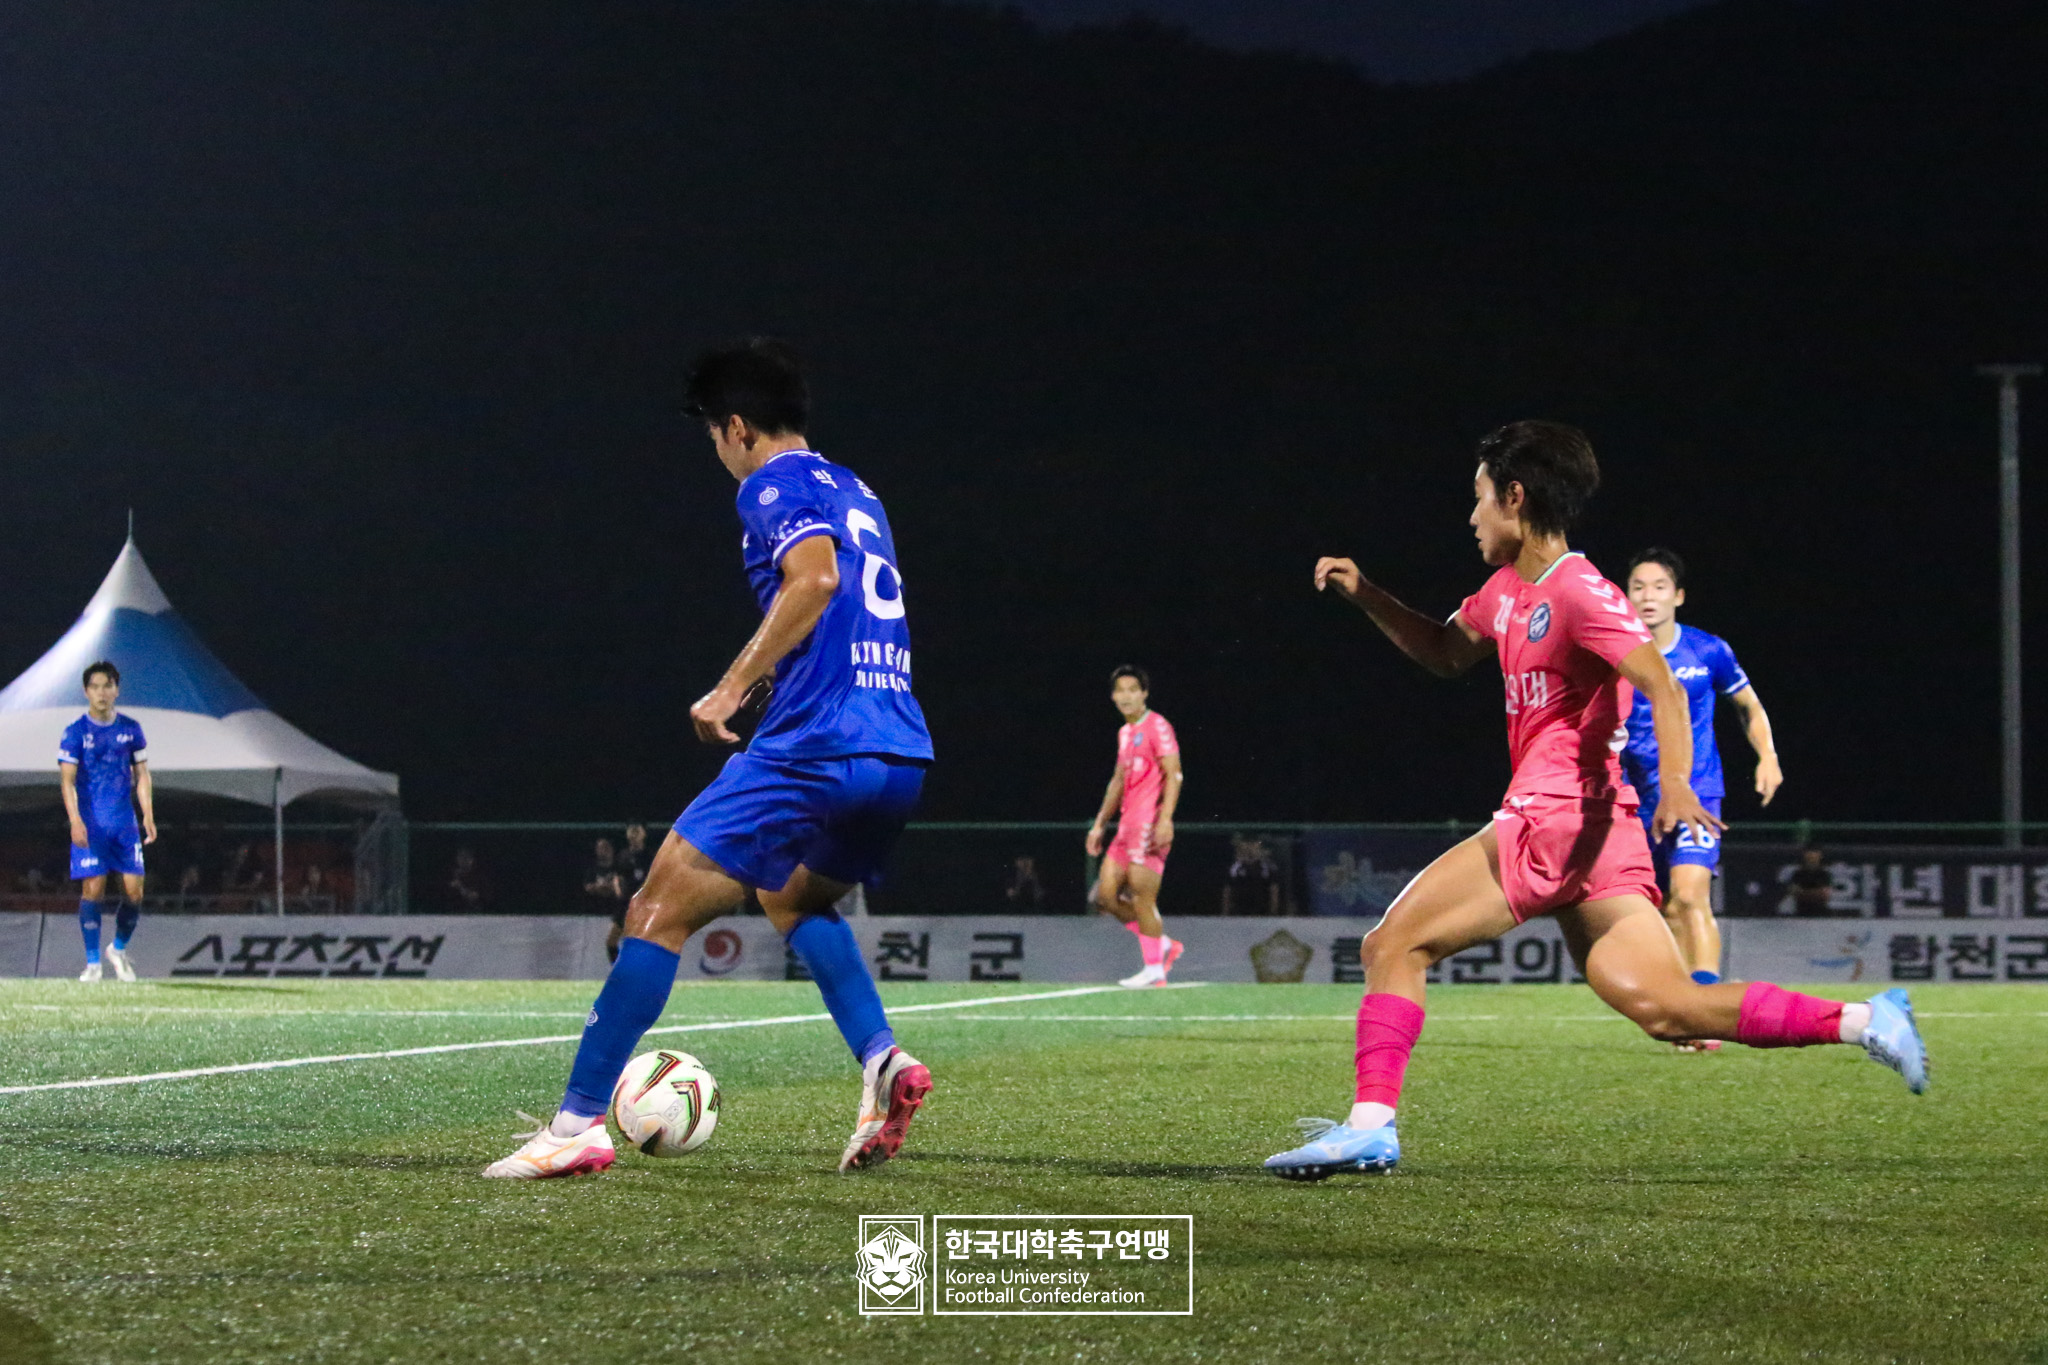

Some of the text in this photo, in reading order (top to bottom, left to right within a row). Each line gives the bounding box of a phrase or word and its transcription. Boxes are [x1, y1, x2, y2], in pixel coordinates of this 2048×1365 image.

[846, 508, 905, 620] 6
[1676, 822, 1716, 849] 26
[170, 933, 445, 977] 스포츠조선
[785, 931, 1024, 981] 천군
